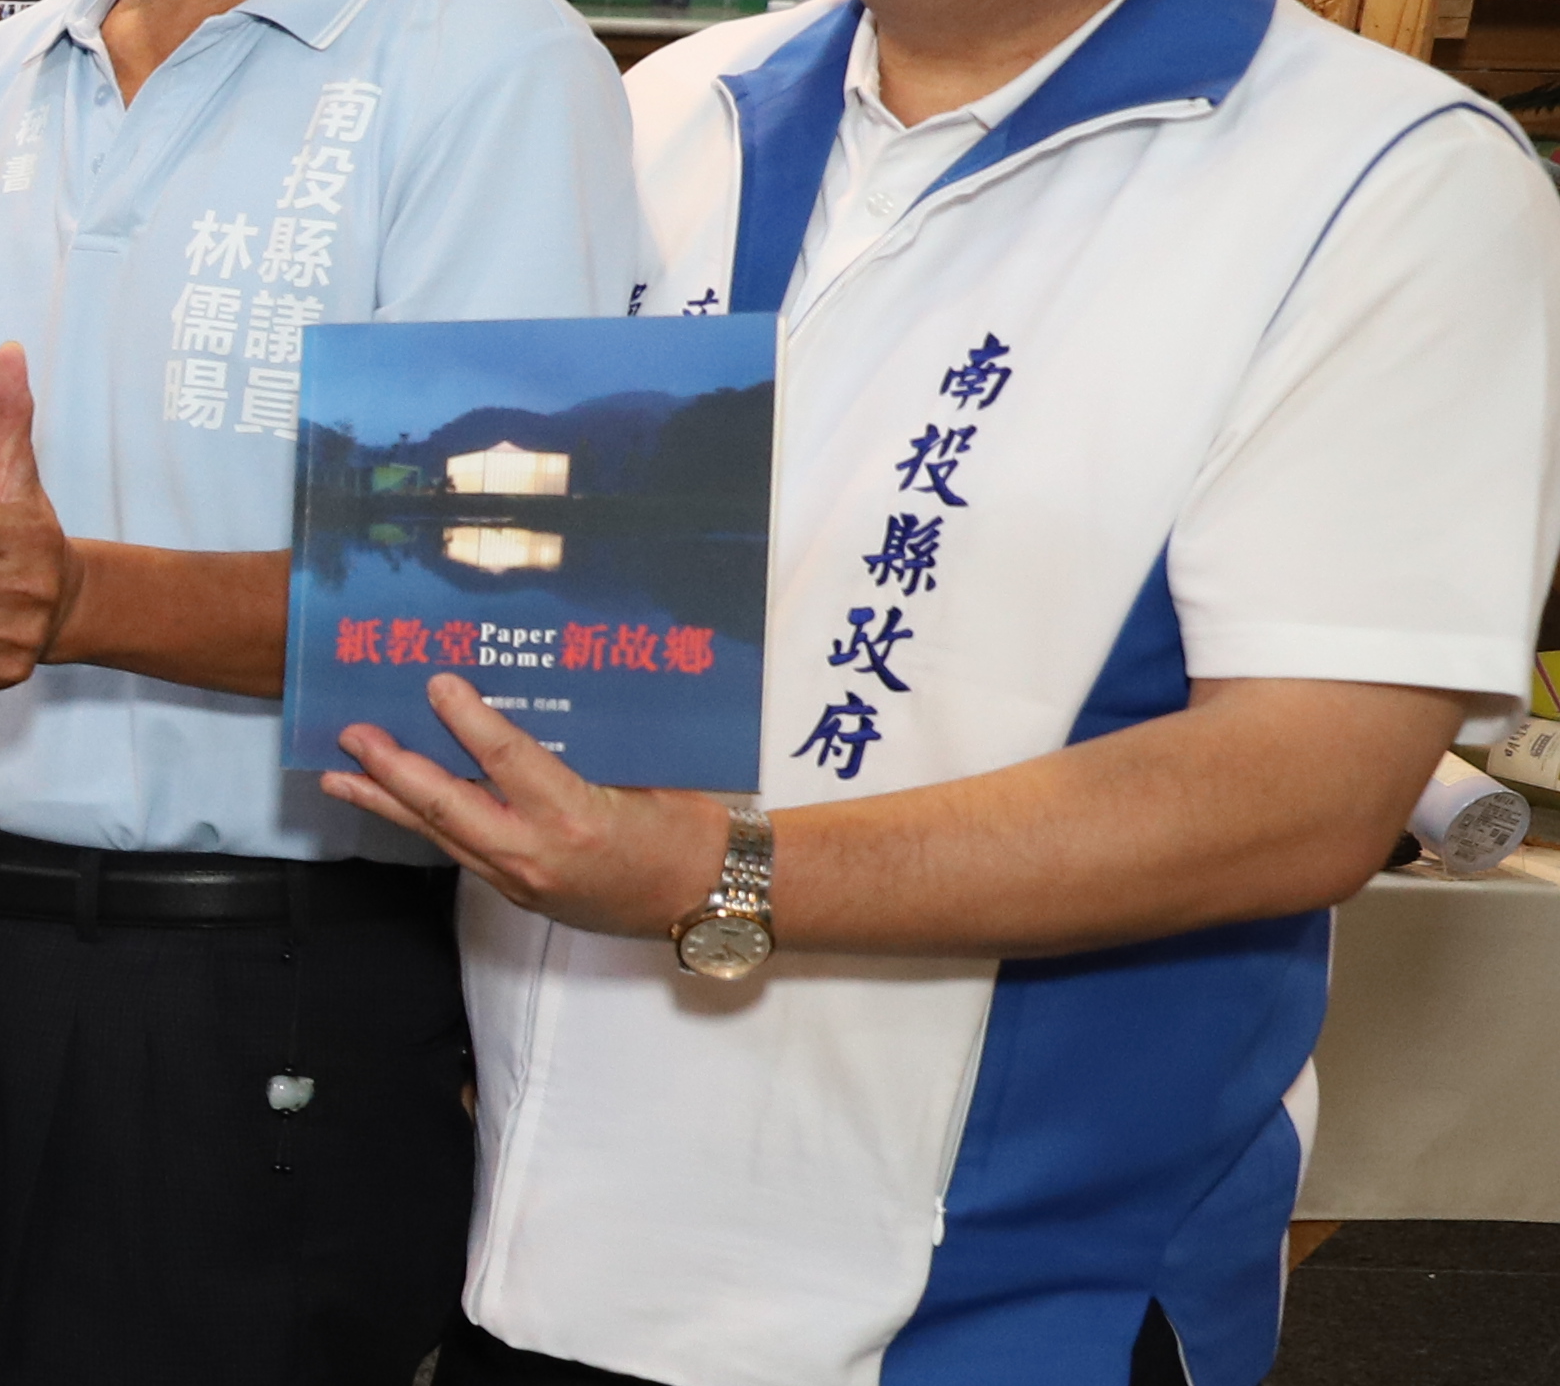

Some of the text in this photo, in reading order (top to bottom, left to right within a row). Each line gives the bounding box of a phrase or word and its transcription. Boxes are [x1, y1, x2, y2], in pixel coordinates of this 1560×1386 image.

[233, 78, 383, 443] 南投縣議員
[335, 617, 715, 674] 紙教堂 Paper 新故鄉
[479, 647, 555, 668] Dome
[793, 332, 1011, 782] 南投縣政府
